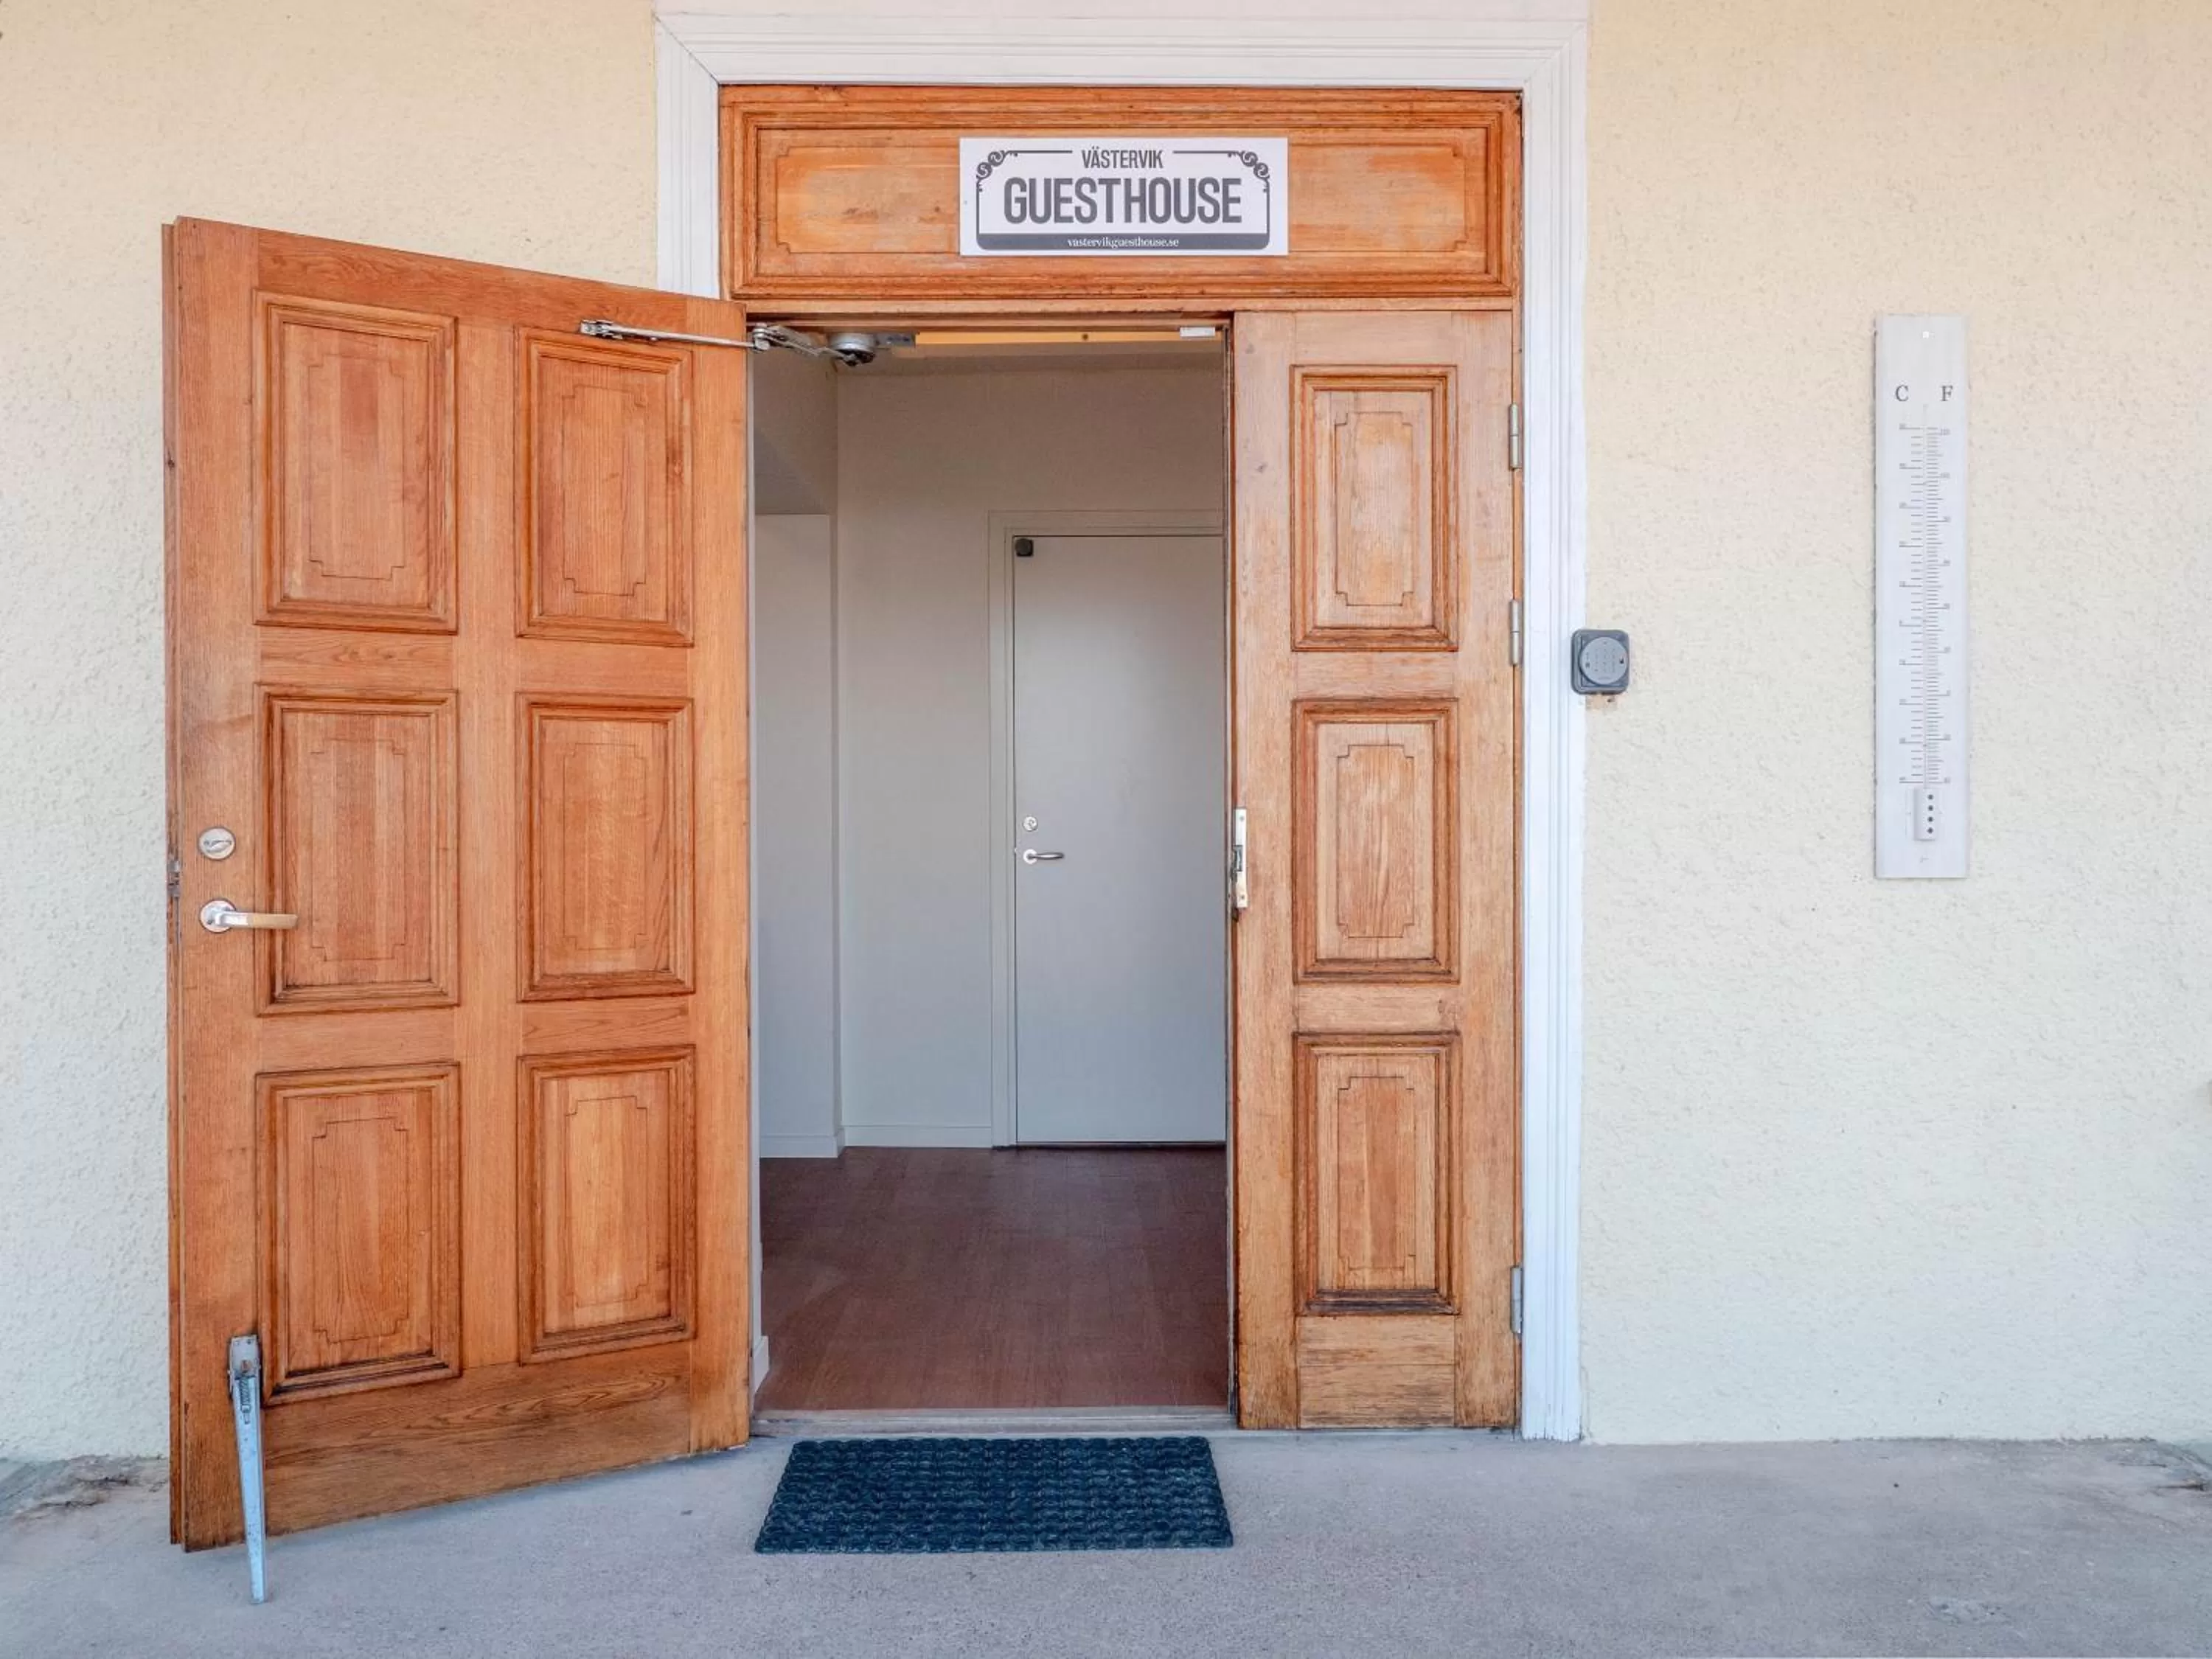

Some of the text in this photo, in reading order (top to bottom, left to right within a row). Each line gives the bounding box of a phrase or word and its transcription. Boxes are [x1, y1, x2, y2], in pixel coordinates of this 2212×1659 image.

[1082, 146, 1164, 169] VÄSTERVIK
[1004, 177, 1242, 224] GUESTHOUSE
[1067, 237, 1180, 248] vastervikguesthouse.se
[1895, 385, 1909, 402] C
[1941, 385, 1953, 402] F
